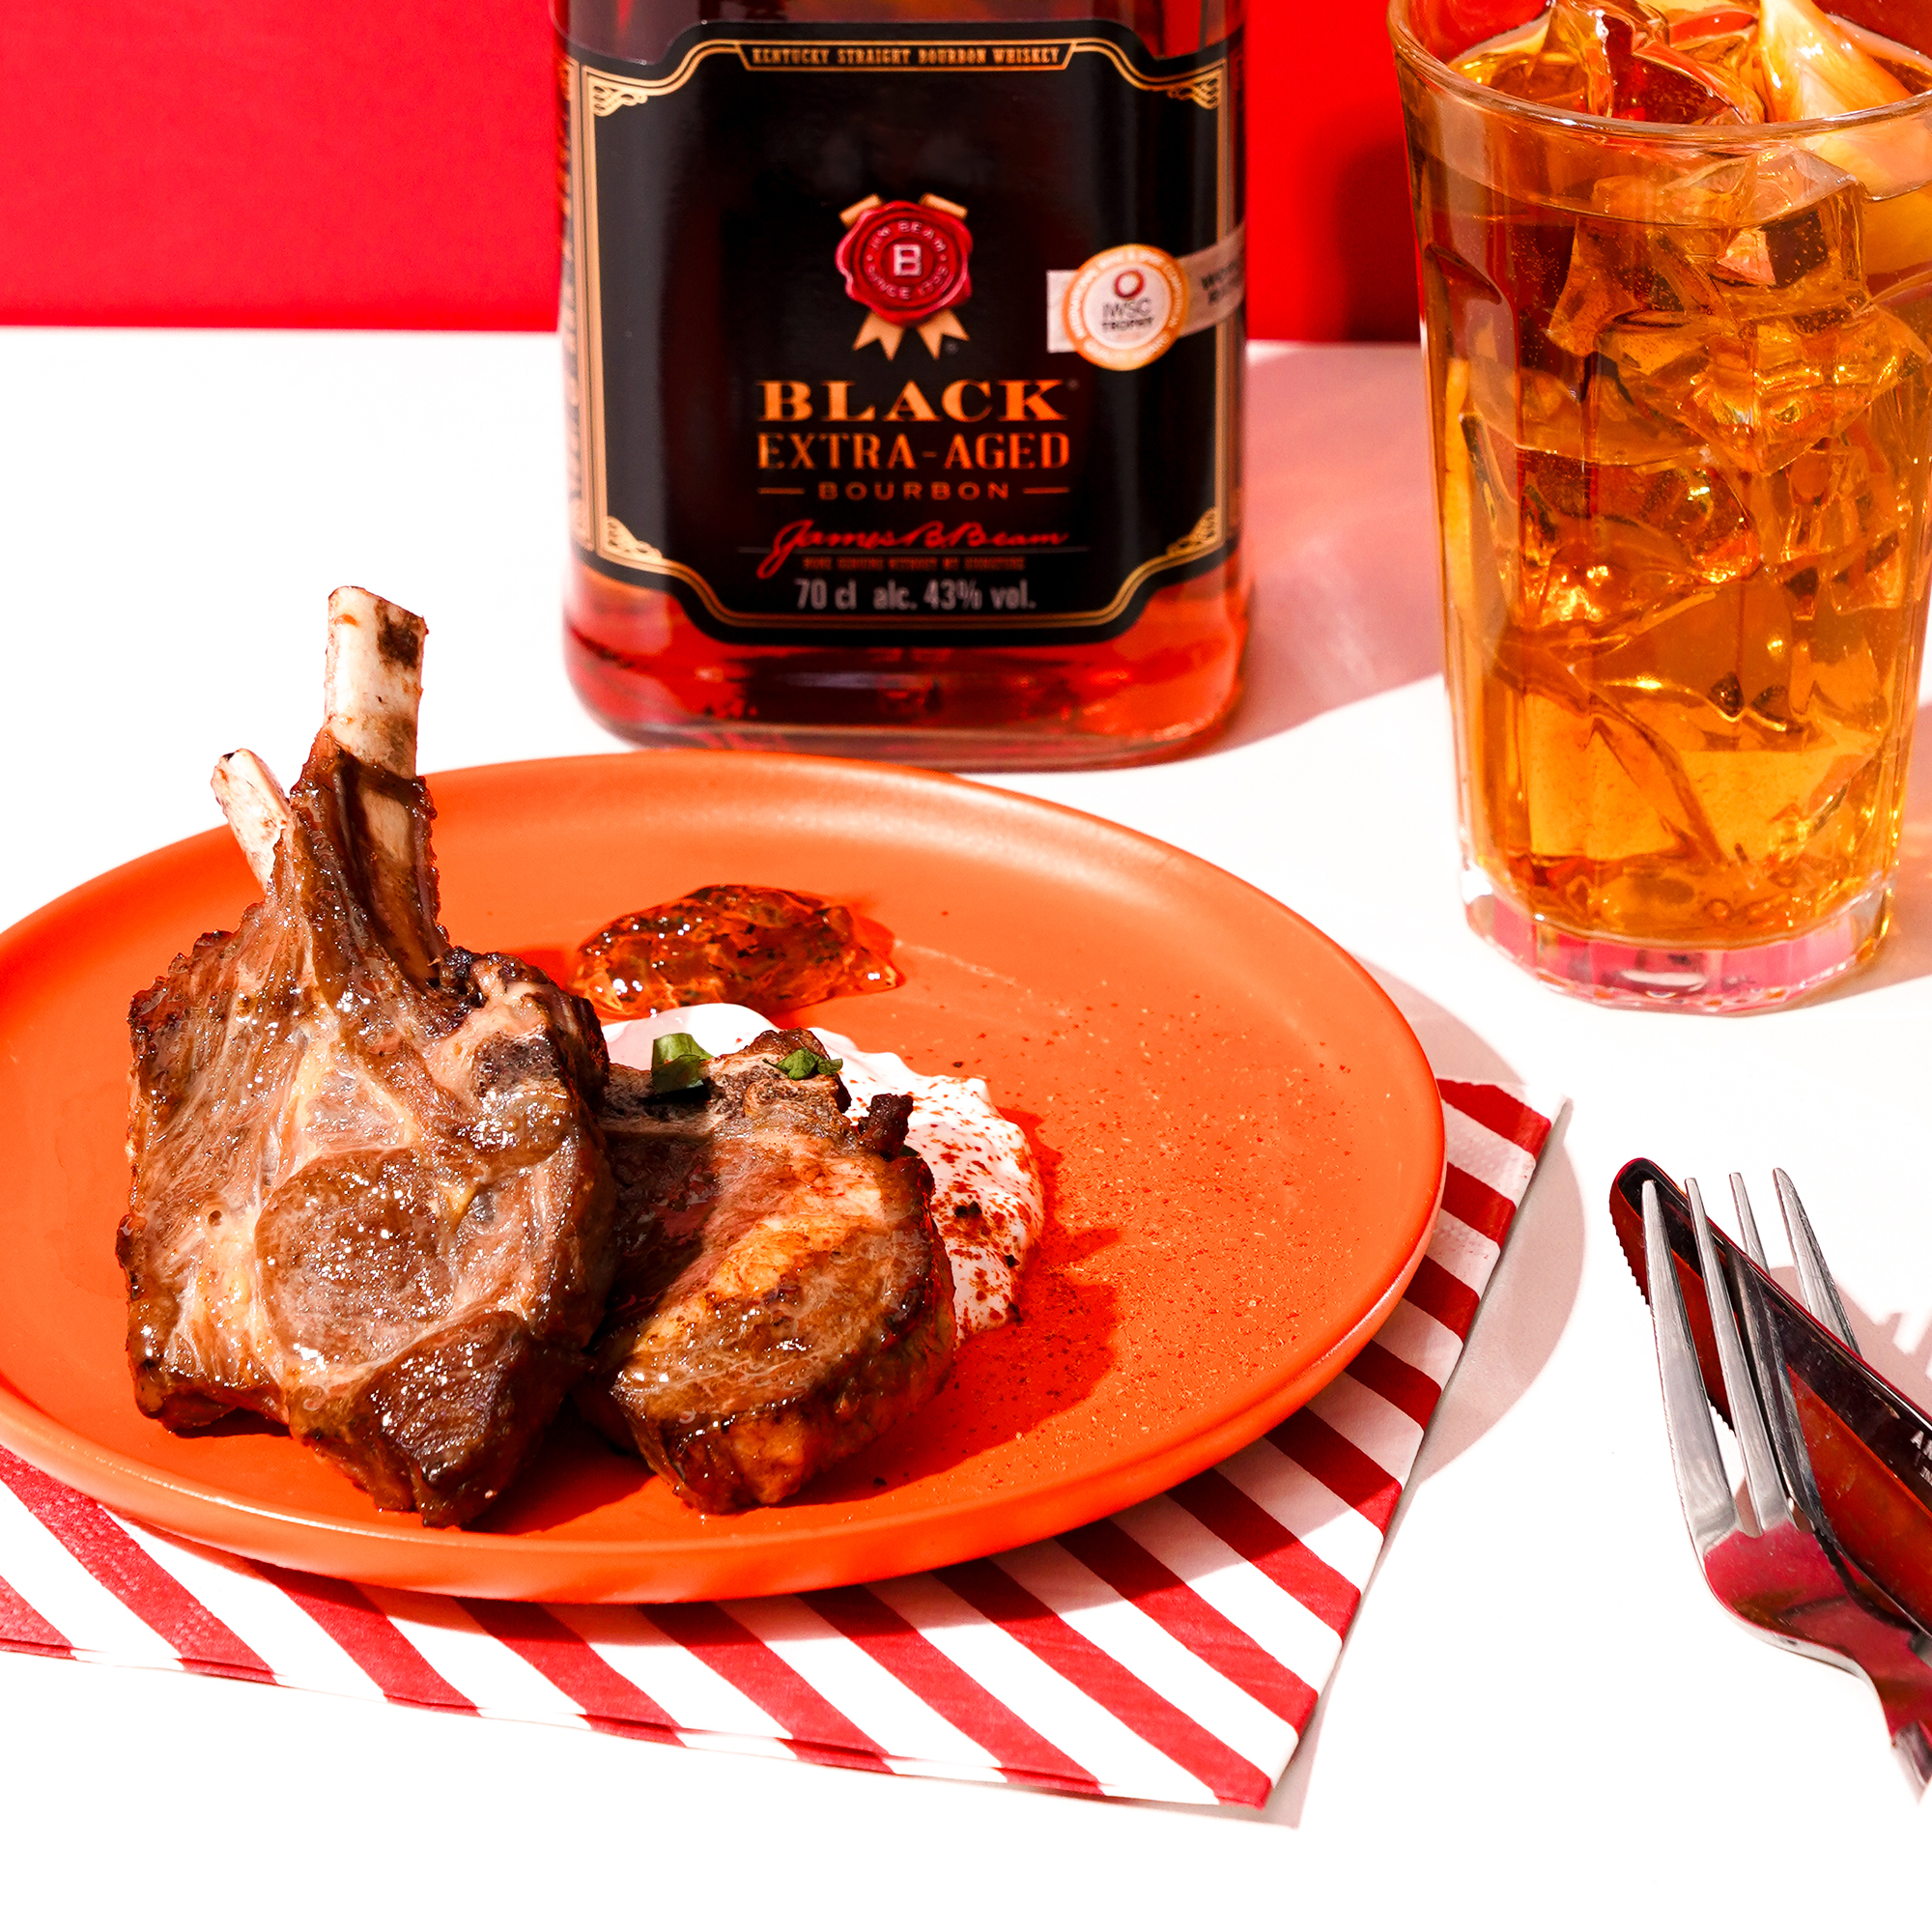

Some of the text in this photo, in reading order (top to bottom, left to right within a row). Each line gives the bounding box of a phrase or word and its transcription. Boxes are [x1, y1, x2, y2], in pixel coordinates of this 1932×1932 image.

[752, 47, 1061, 65] KENTUCKY STRAIGHT BOURBON WHISKEY
[897, 219, 947, 252] BEAM
[893, 243, 923, 276] B
[757, 379, 1067, 422] BLACK
[757, 432, 1070, 469] EXTRA-AGED
[817, 481, 1009, 500] BOURBON
[795, 579, 1037, 611] 70 cl alc. 43% vol.
